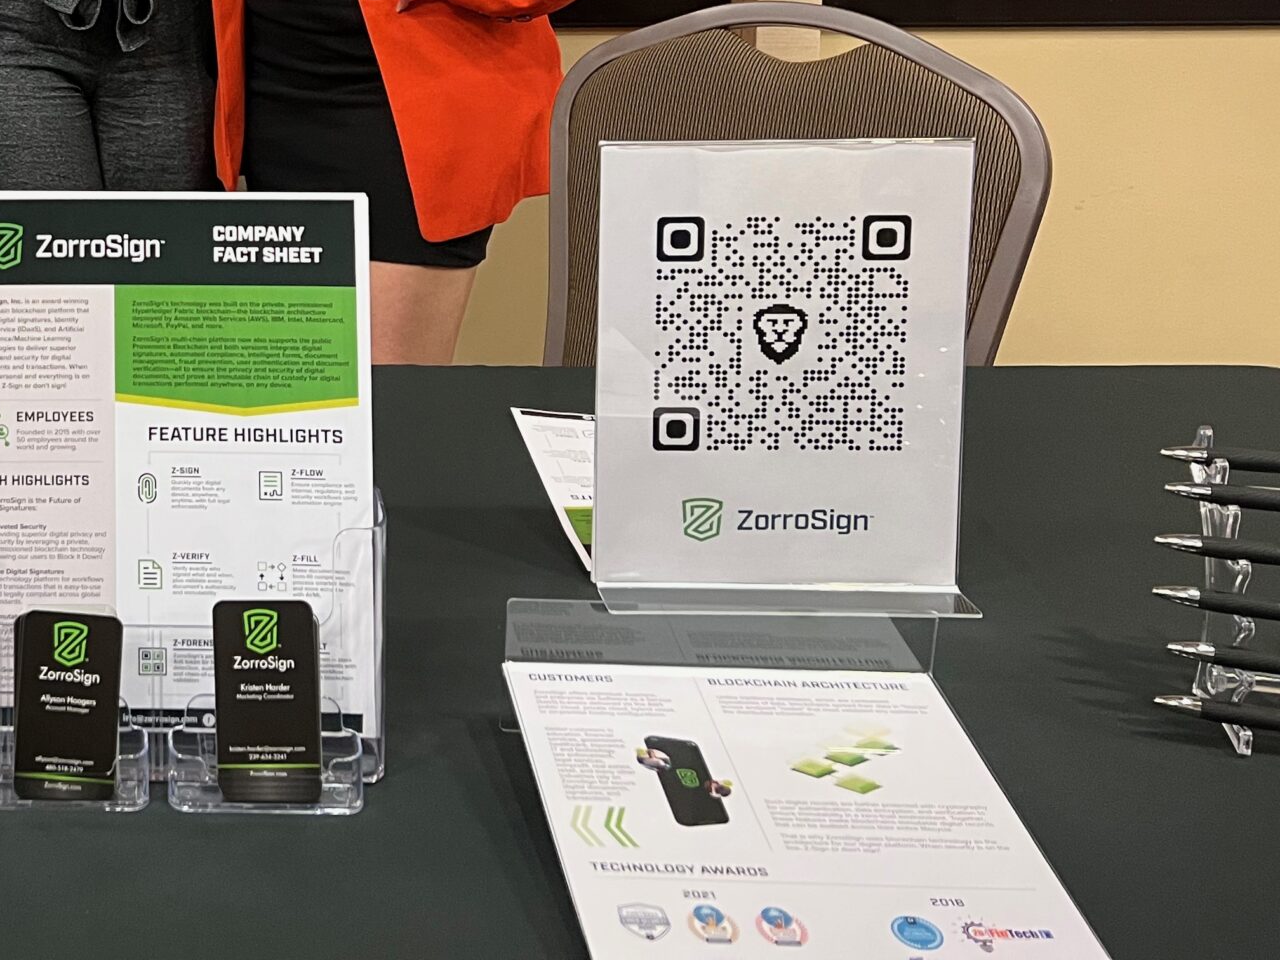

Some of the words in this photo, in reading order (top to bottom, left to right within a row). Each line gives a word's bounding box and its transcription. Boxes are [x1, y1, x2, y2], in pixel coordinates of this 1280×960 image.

[213, 225, 304, 242] COMPANY
[36, 234, 161, 262] ZorroSign
[213, 247, 259, 262] FACT
[262, 247, 322, 263] SHEET
[16, 411, 94, 422] EMPLOYEES
[148, 427, 228, 442] FEATURE
[234, 428, 343, 444] HIGHLIGHTS
[12, 475, 89, 486] HIGHLIGHTS
[291, 469, 323, 477] Z-FLOW
[737, 509, 869, 534] ZorroSign
[234, 656, 295, 672] ZorroSign
[39, 666, 100, 686] ZorroSign
[529, 673, 613, 682] CUSTOMERS
[707, 678, 798, 688] BLOCKCHAIN
[801, 681, 909, 690] ARCHITECTURE
[590, 861, 695, 874] TECHNOLOGY
[701, 865, 769, 877] AWARDS
[683, 890, 717, 899] 2021
